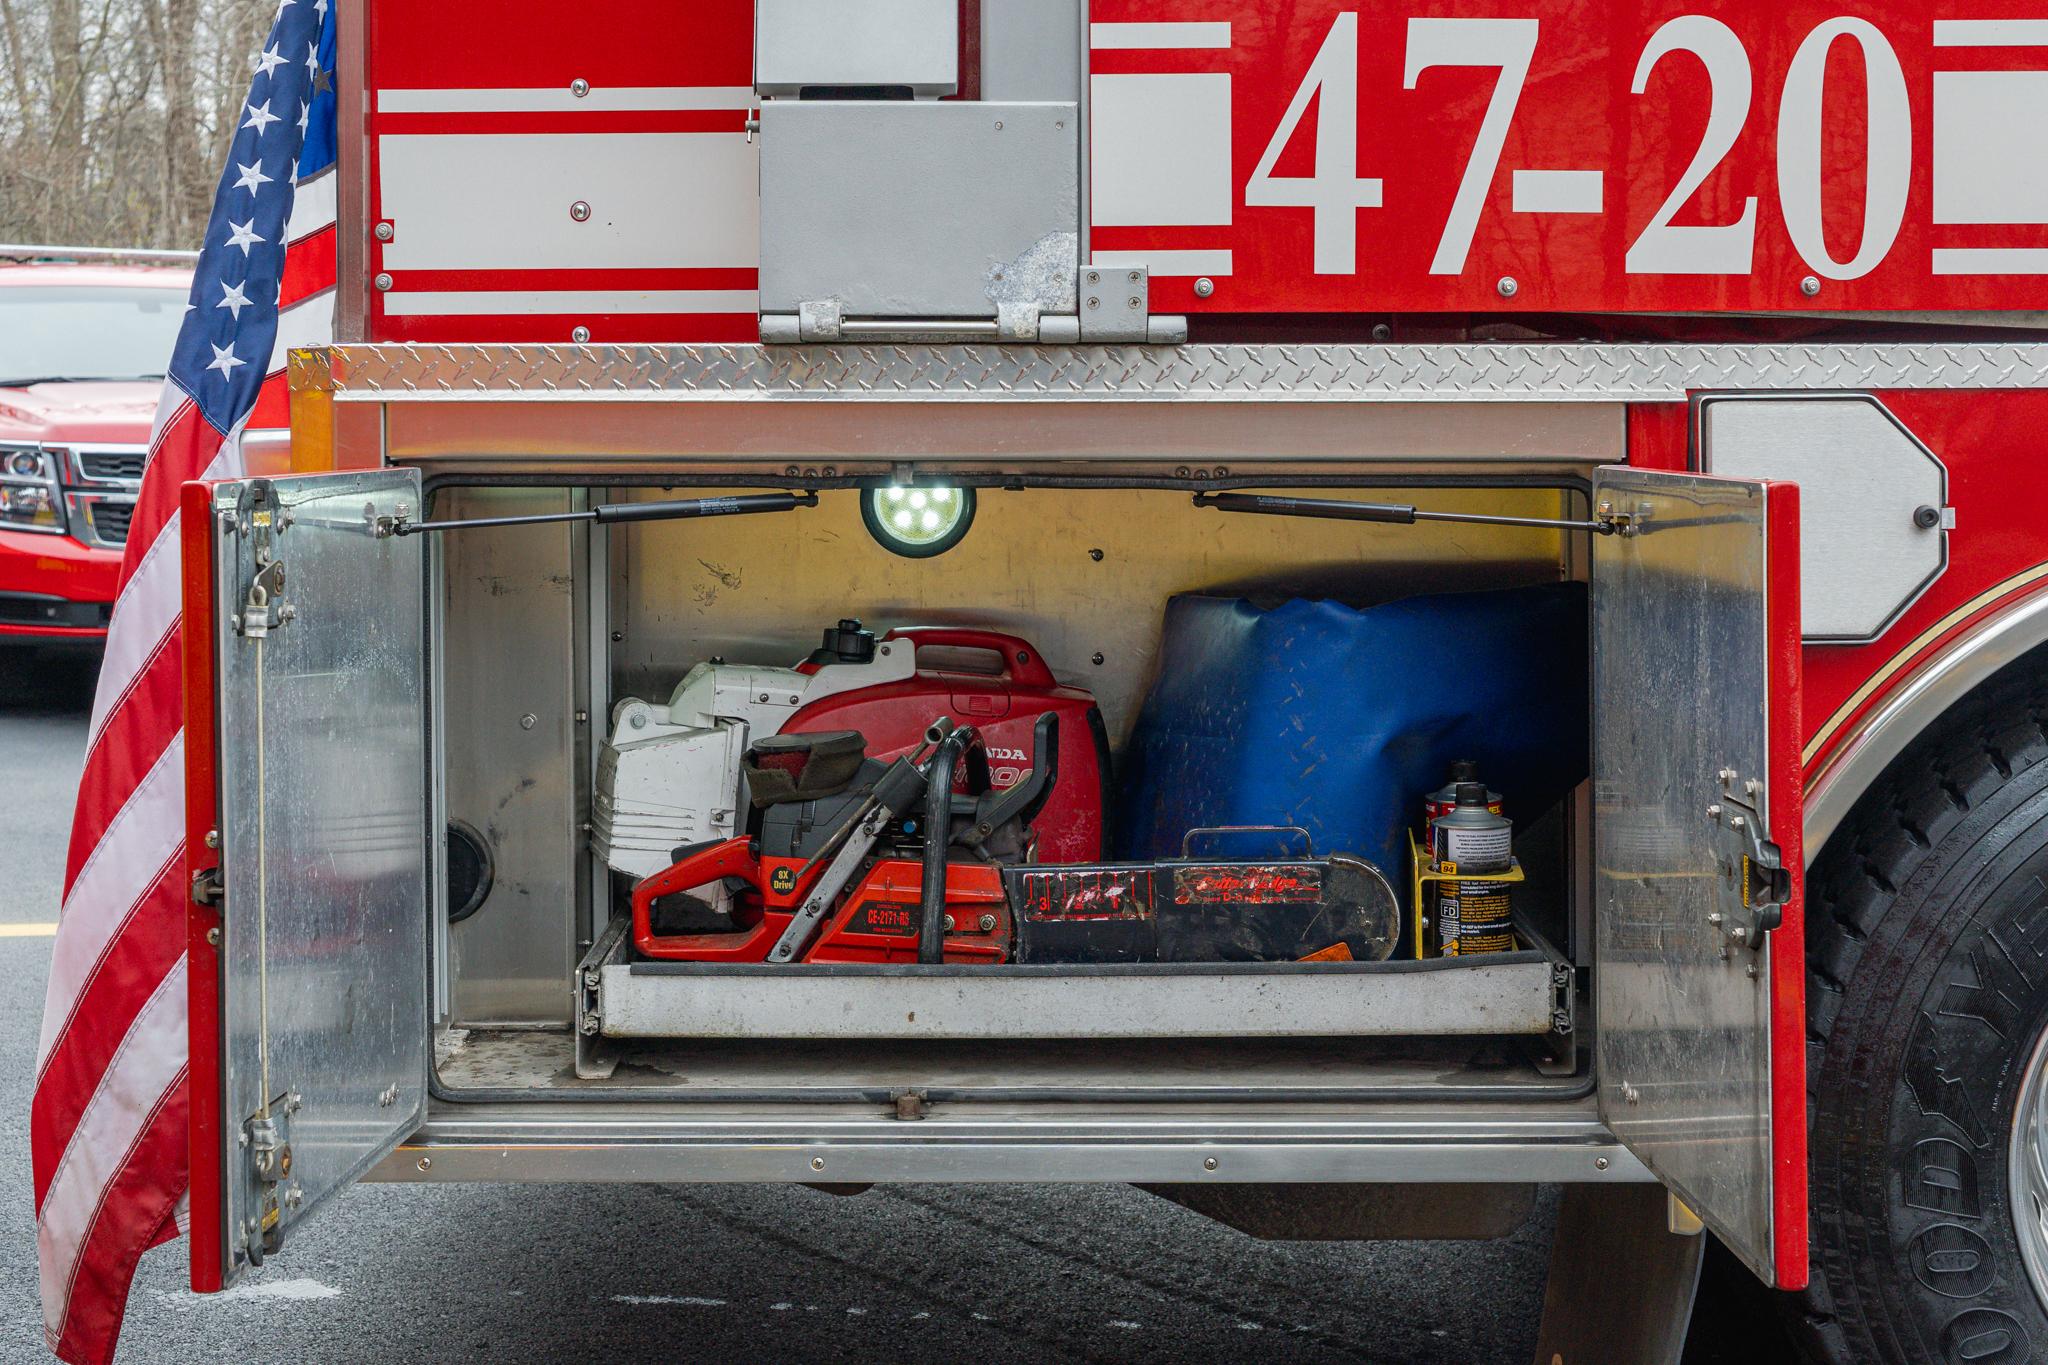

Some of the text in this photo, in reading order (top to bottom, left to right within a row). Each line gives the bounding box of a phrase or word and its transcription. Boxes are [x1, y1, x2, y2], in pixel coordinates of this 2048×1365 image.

[1245, 11, 1912, 281] 47-20
[985, 747, 1027, 761] NDA
[1442, 865, 1454, 874] 94
[773, 880, 794, 890] Drive
[1443, 906, 1456, 916] FD
[1904, 874, 2048, 1365] OODYE
